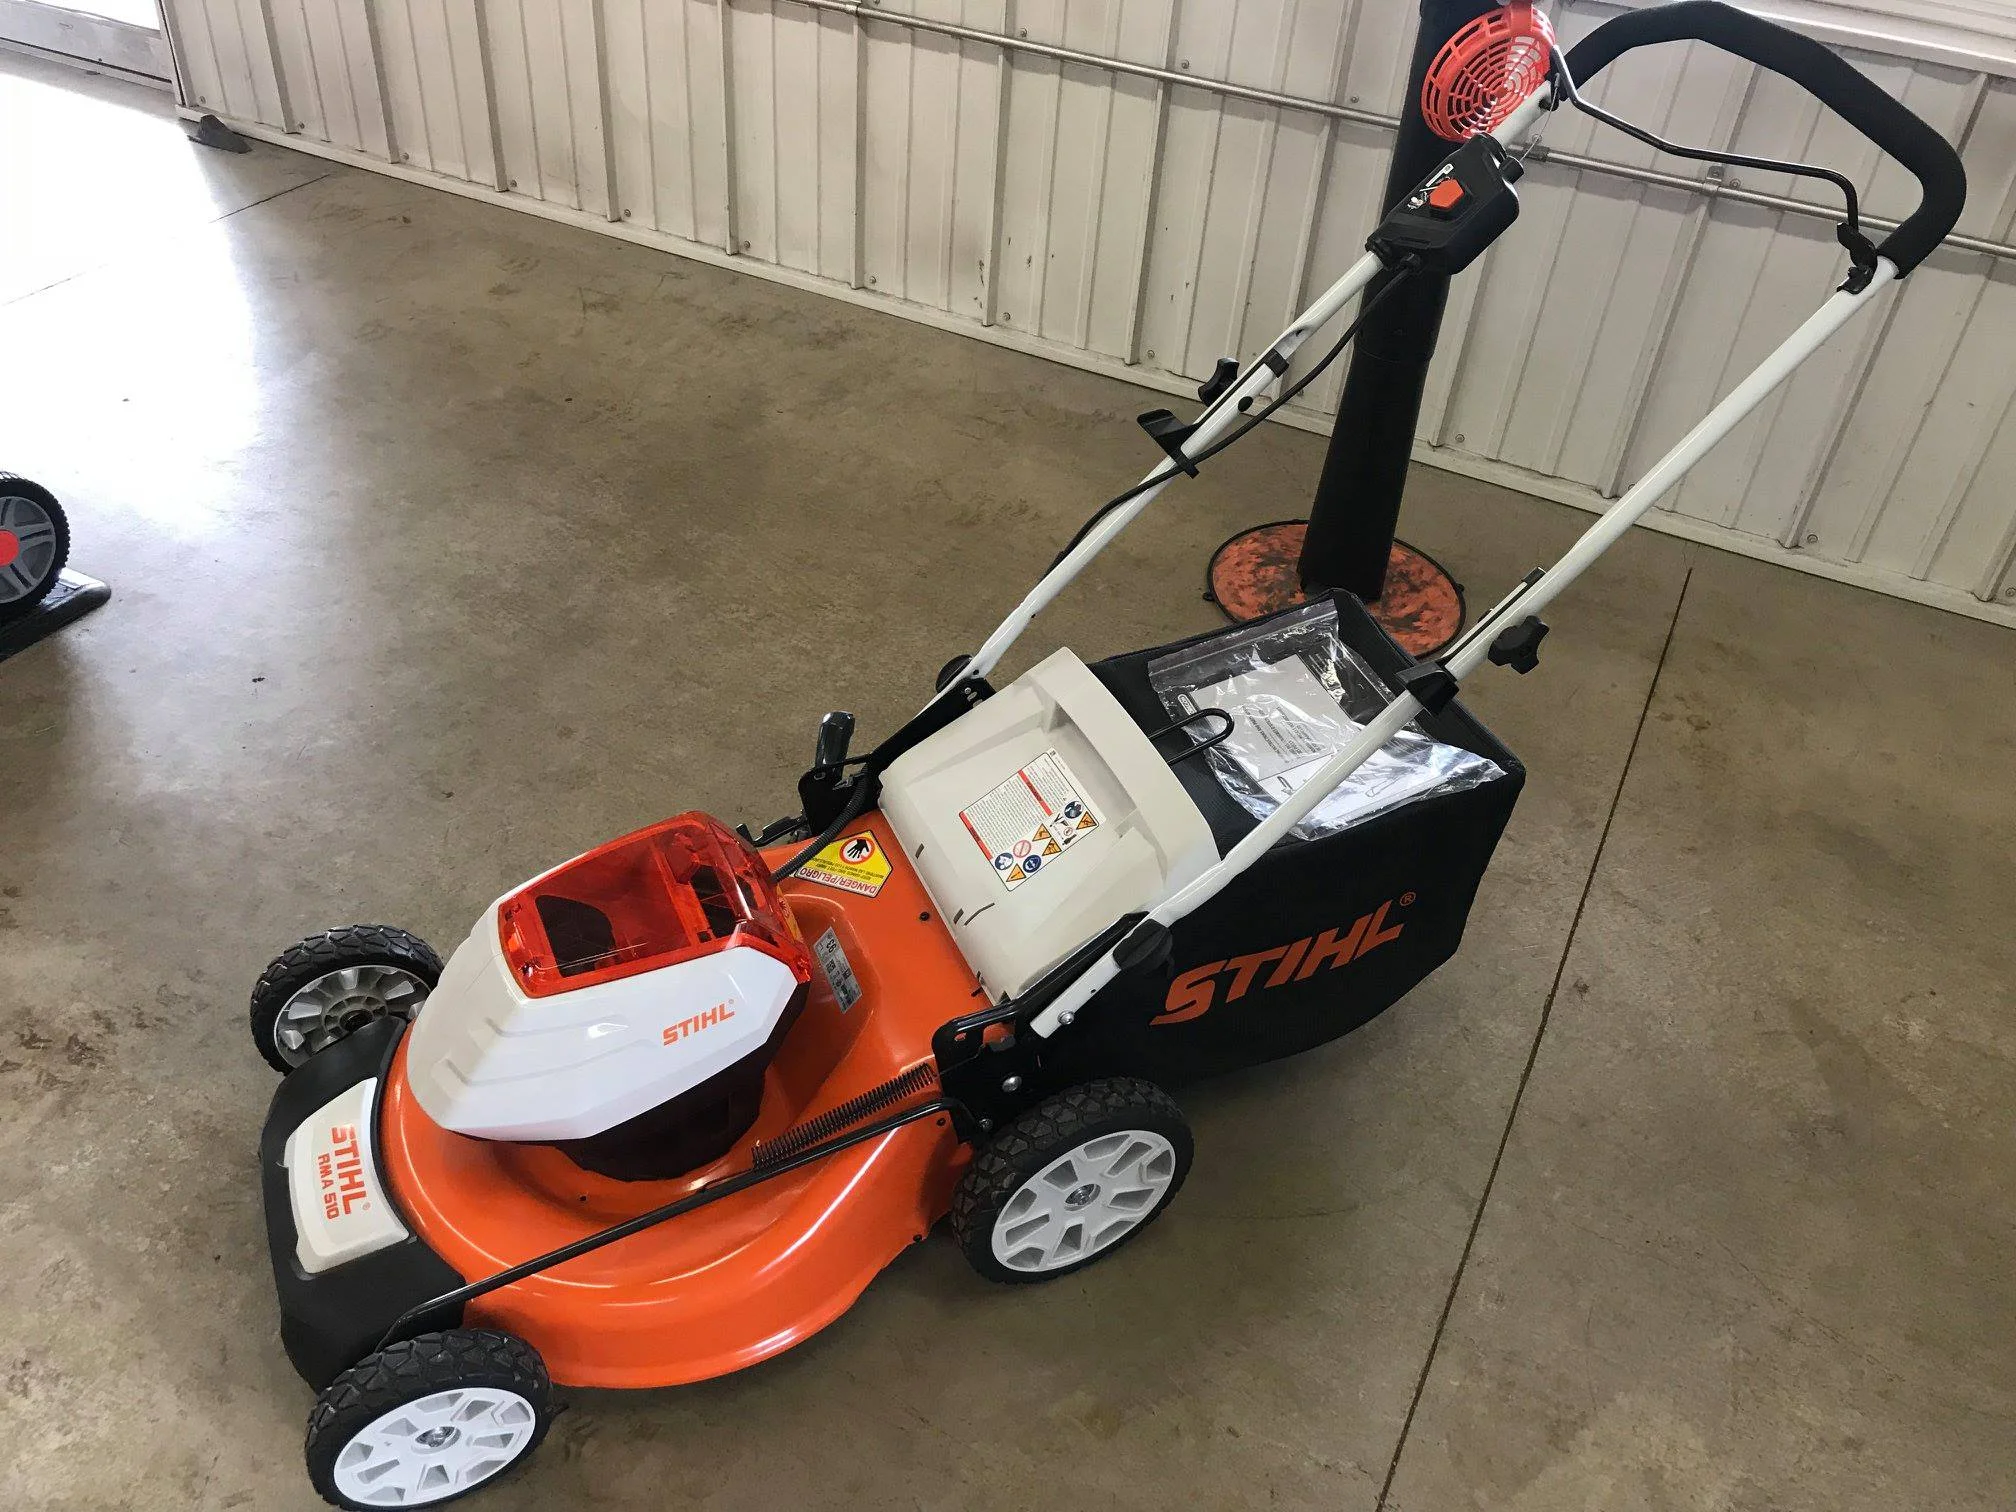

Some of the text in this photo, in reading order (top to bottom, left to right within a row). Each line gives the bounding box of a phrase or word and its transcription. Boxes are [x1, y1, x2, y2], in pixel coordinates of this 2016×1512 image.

[800, 867, 877, 894] DANGER/PELIGRO
[1150, 900, 1404, 1026] STIHL
[663, 1003, 735, 1046] STIHL
[318, 1153, 340, 1220] RMA 510
[331, 1125, 366, 1214] STIHL
